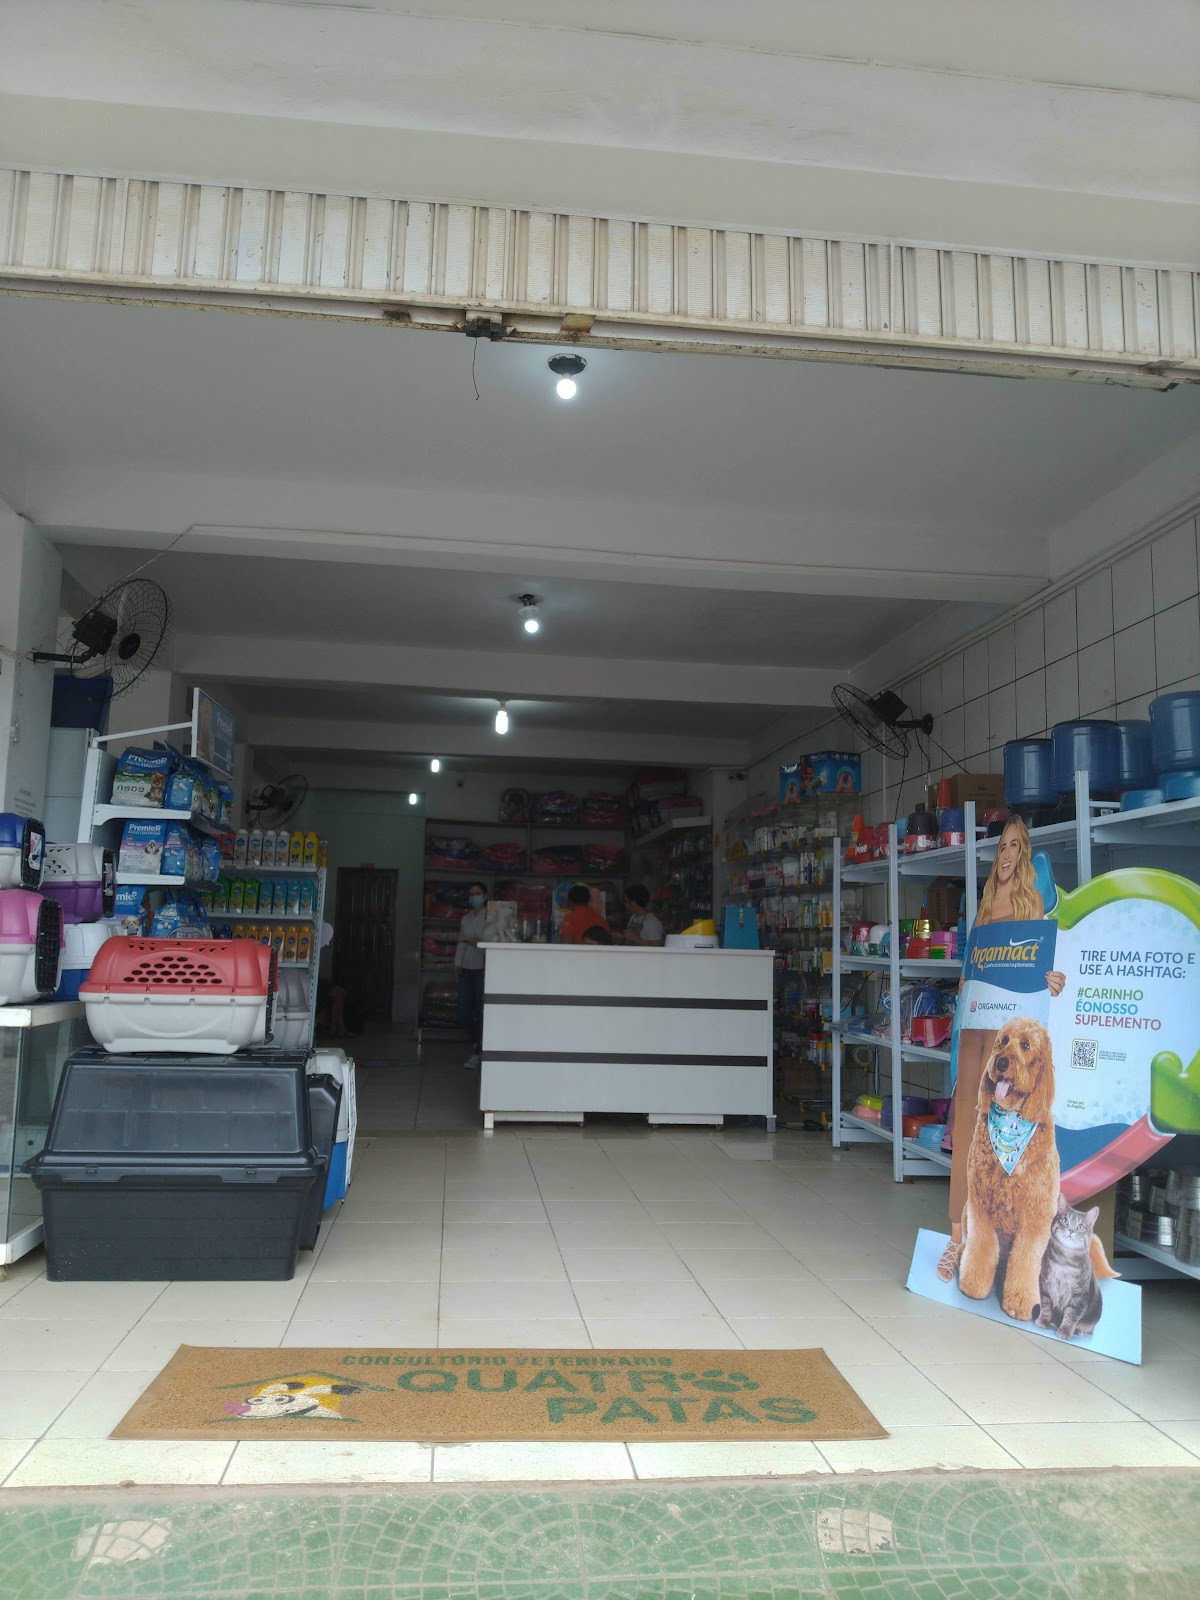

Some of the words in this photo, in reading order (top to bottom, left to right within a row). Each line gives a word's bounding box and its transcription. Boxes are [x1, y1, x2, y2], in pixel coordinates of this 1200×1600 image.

[970, 943, 1039, 971] Organnact
[1081, 950, 1107, 962] TIRE
[1110, 951, 1141, 963] UMA
[1145, 952, 1183, 964] FOTO
[1188, 953, 1195, 965] E
[1079, 964, 1102, 976] USE
[1104, 965, 1113, 976] A
[1117, 965, 1185, 979] HASHTAG:
[1077, 987, 1143, 1001] #CARINHO
[978, 1002, 1017, 1011] ORGANNACT
[1076, 999, 1138, 1015] ÉONOSSO
[1075, 1014, 1161, 1031] SUPLEMENTO
[546, 1396, 817, 1424] PATAS
